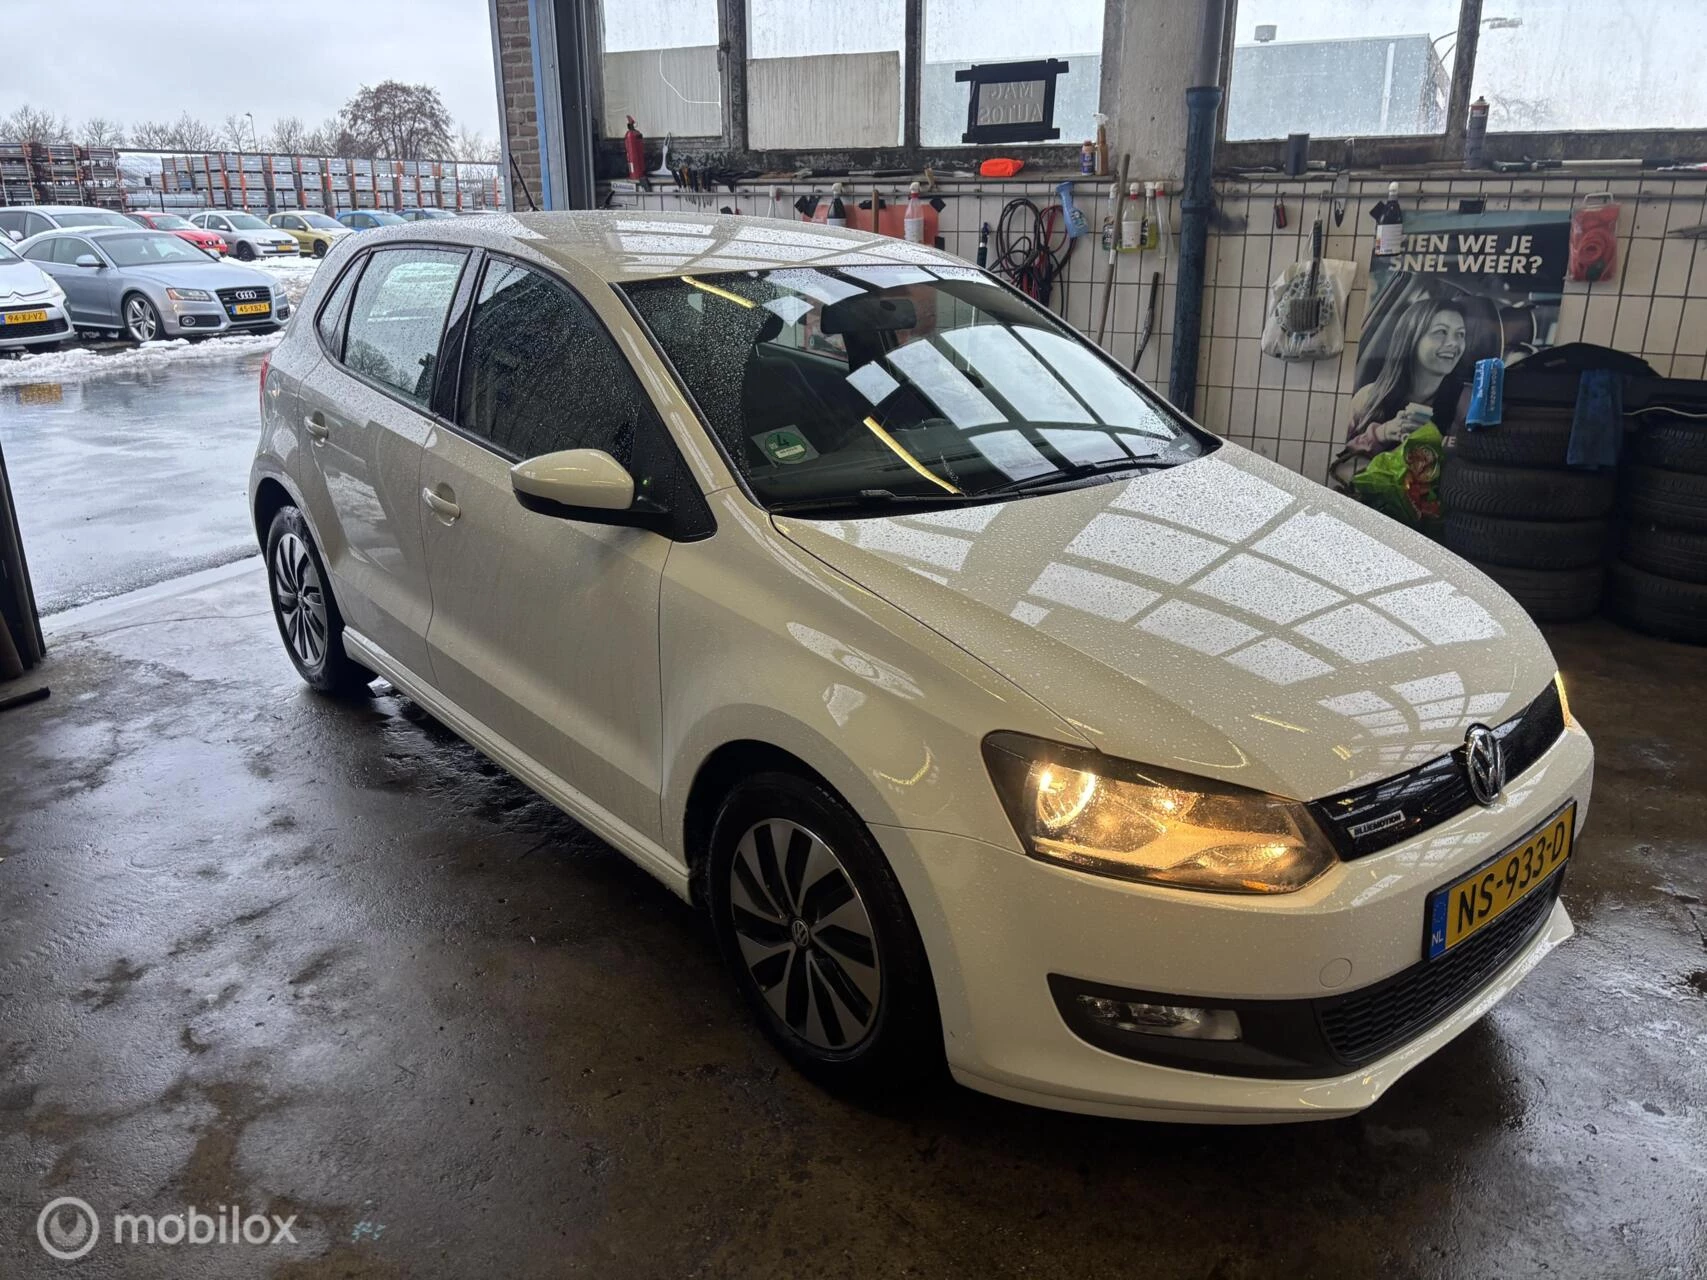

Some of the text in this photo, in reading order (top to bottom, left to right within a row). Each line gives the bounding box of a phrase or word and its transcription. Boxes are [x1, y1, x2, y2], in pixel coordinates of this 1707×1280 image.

[1458, 235, 1497, 253] WE
[1505, 235, 1533, 254] JE
[1389, 255, 1543, 274] SNEL WEER?
[1457, 821, 1565, 934] NS-933-D
[1431, 931, 1444, 946] NL
